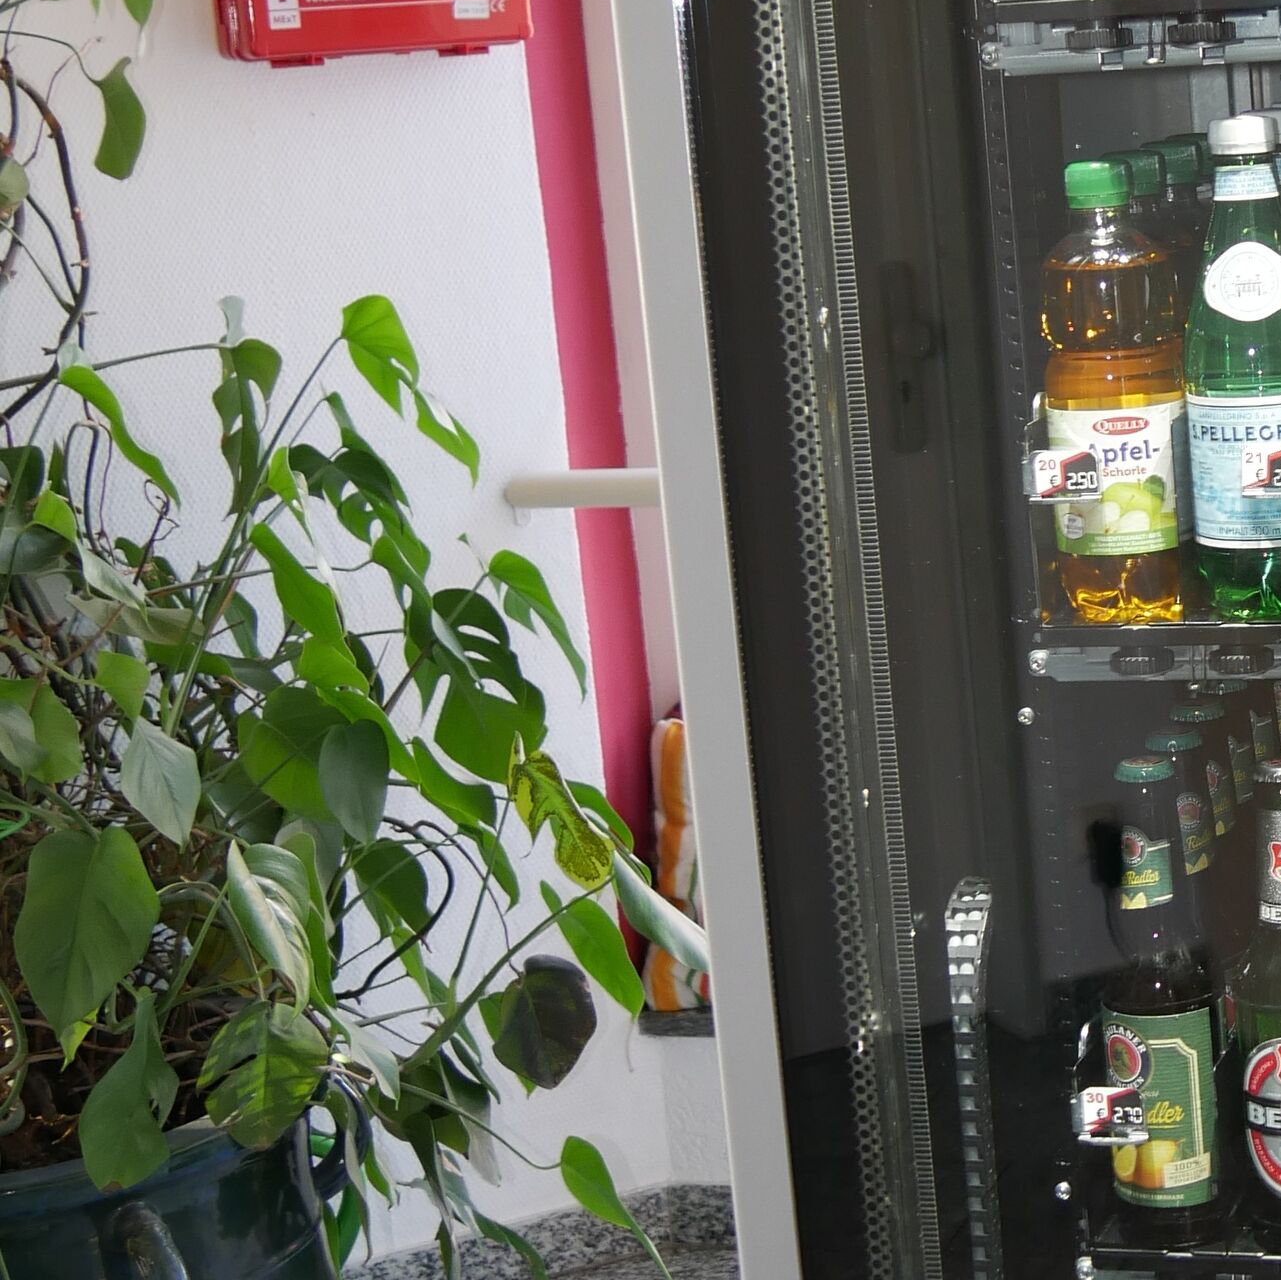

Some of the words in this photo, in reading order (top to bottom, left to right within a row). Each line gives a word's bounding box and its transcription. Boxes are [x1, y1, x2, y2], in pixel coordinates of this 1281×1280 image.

[1097, 418, 1149, 433] QUELLY
[1245, 453, 1262, 463] 21
[1038, 459, 1056, 471] 20
[1103, 465, 1147, 477] Schorle
[1086, 1092, 1104, 1103] 30
[1148, 1101, 1185, 1124] dler
